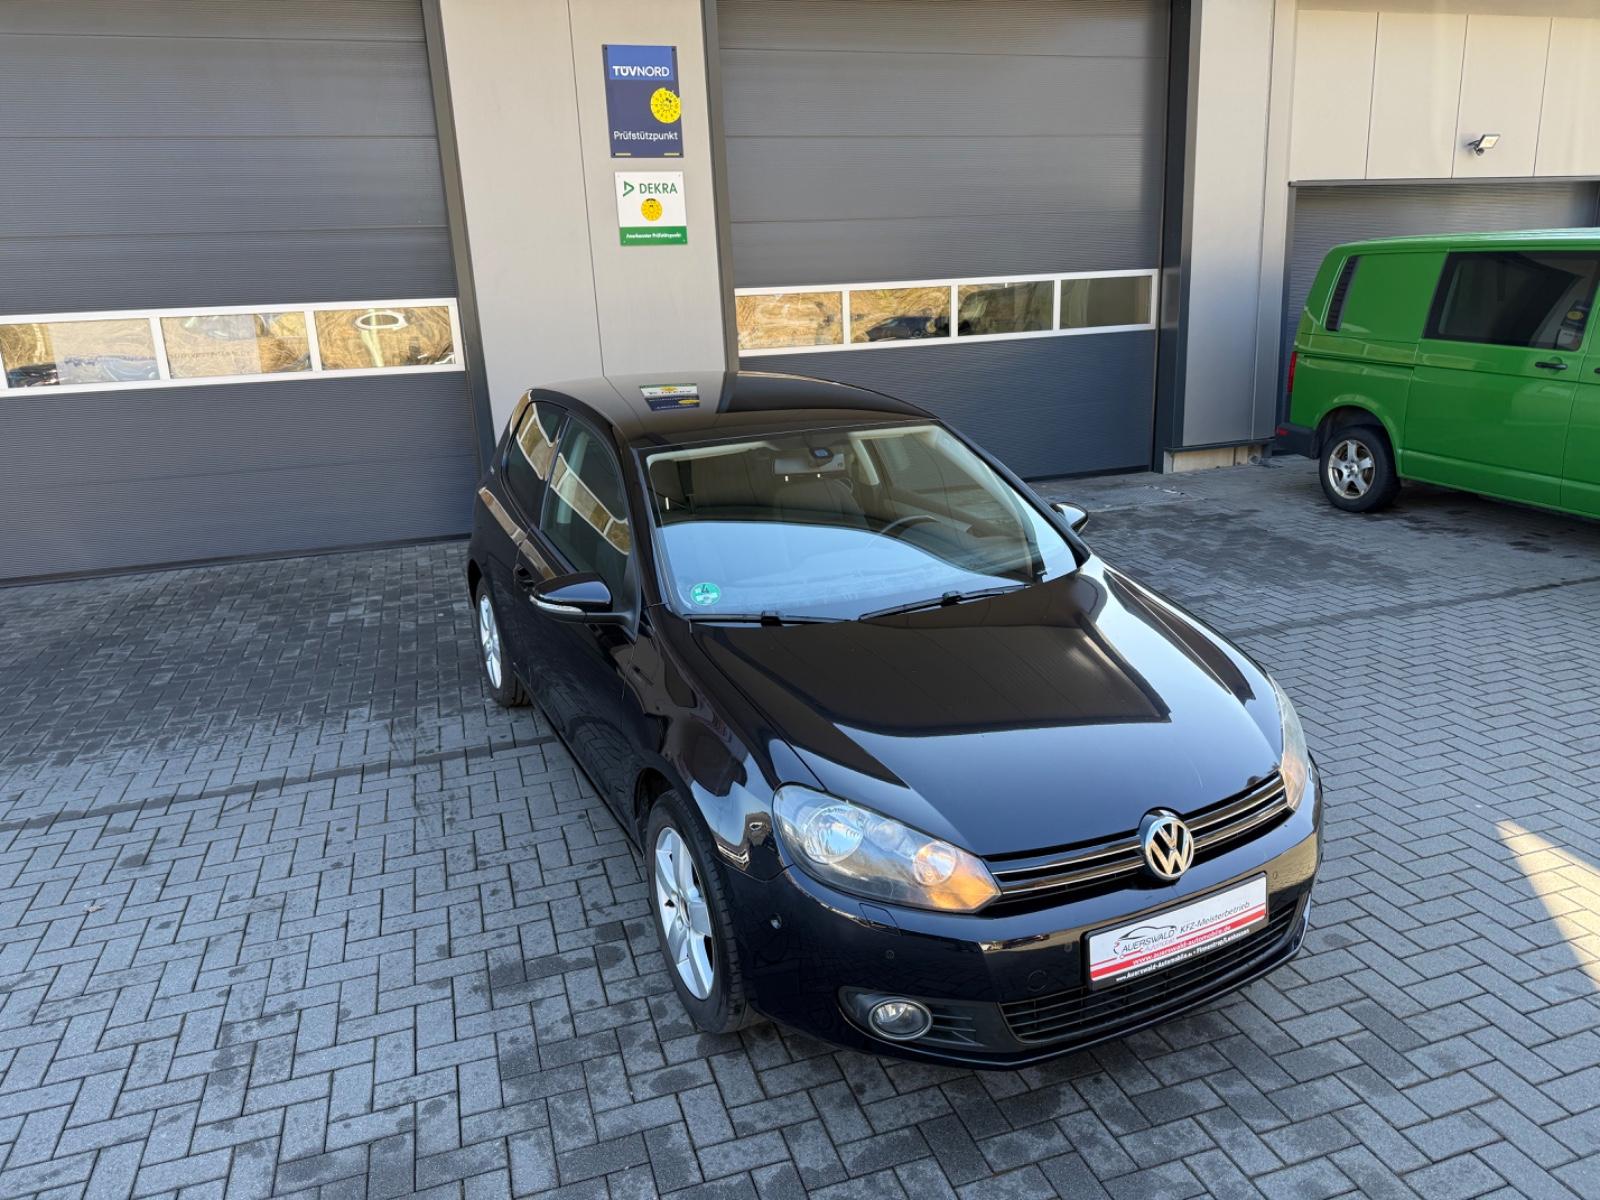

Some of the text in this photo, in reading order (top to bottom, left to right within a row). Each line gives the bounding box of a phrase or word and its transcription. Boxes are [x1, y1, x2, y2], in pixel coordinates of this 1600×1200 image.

[613, 130, 679, 142] Prüfstützpunkt
[639, 182, 678, 195] DEKRA
[1122, 902, 1250, 952] AUERSWALD KFZ-Meisterbetrieb
[1132, 926, 1232, 966] www.auerswald-automobile.de
